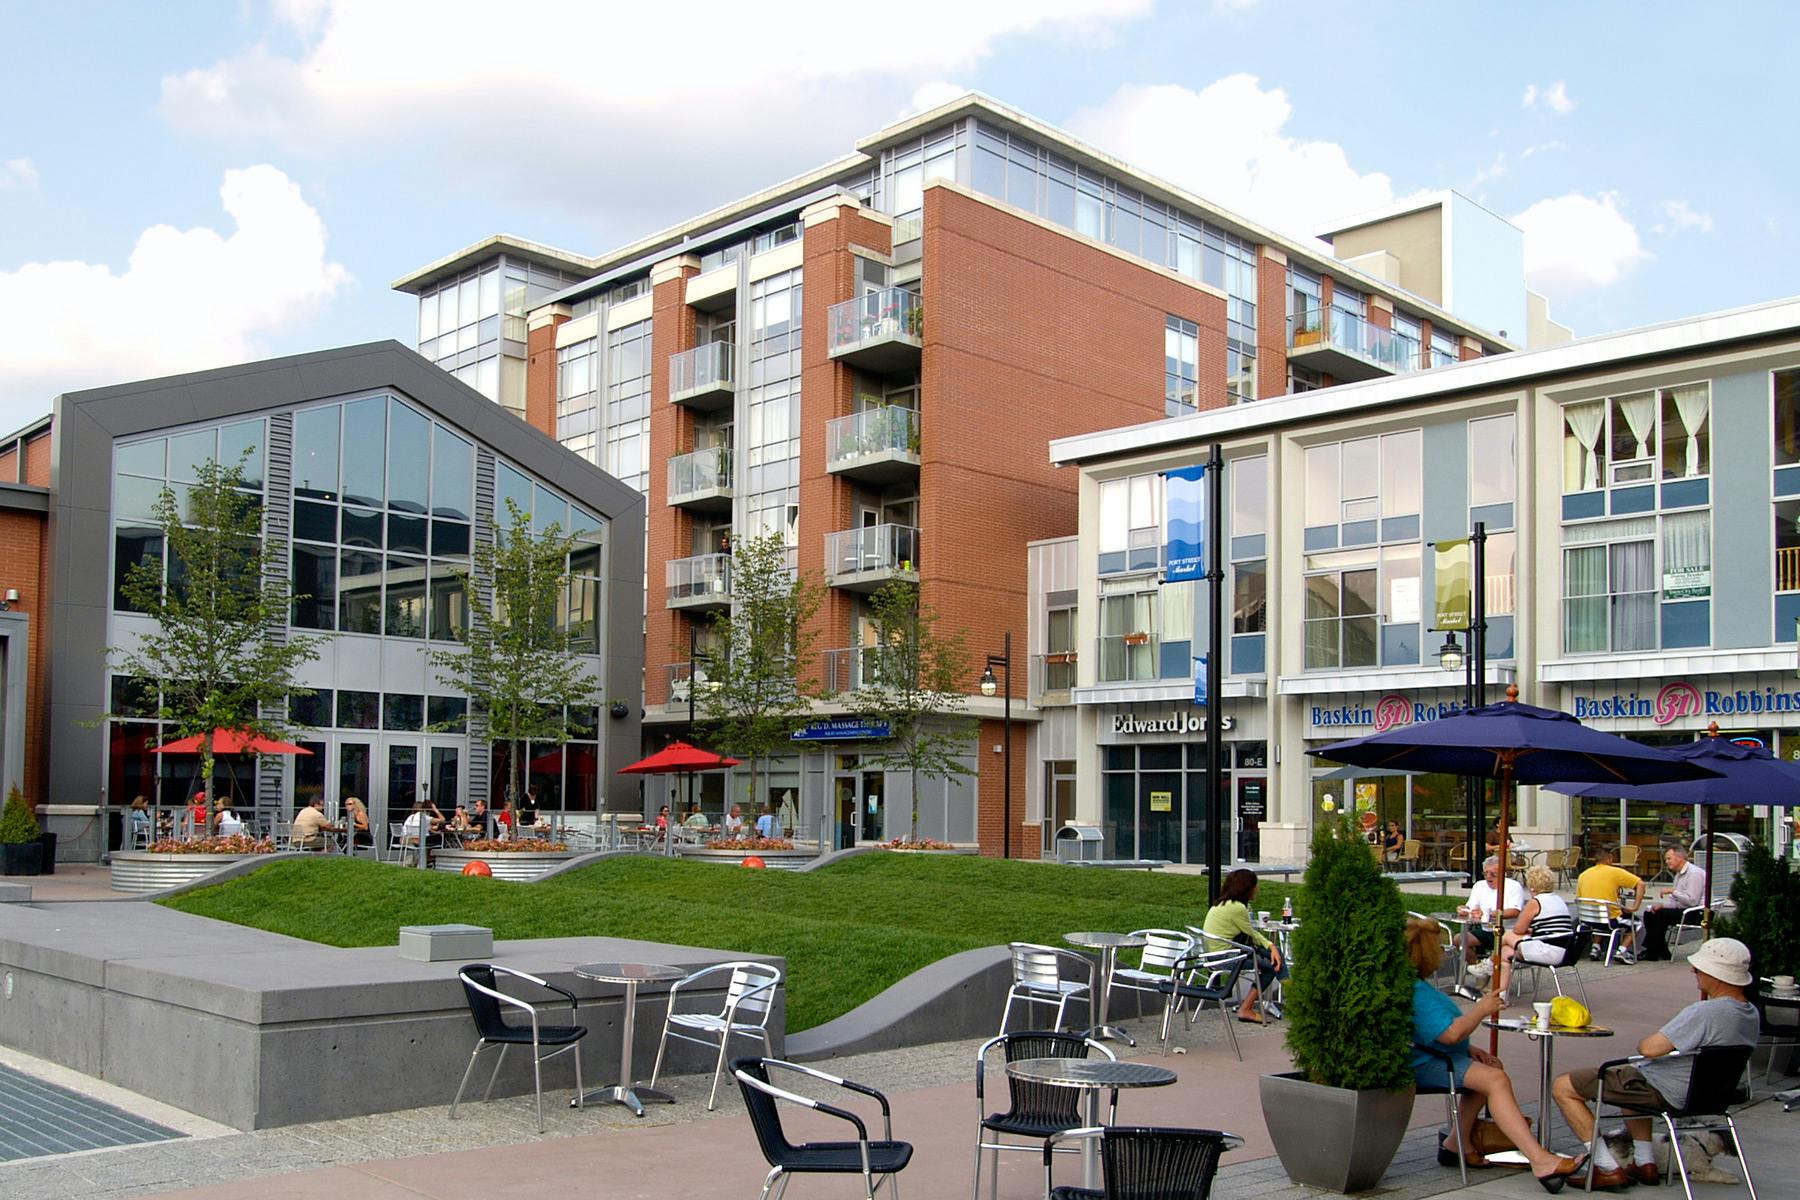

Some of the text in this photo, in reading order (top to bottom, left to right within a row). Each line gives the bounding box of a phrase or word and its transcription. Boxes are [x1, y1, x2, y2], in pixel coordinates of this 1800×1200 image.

[1312, 703, 1373, 726] Baskin
[1574, 686, 1800, 726] Baskin 31 Robbins
[1111, 711, 1179, 734] Edward
[1244, 757, 1263, 767] 80-E
